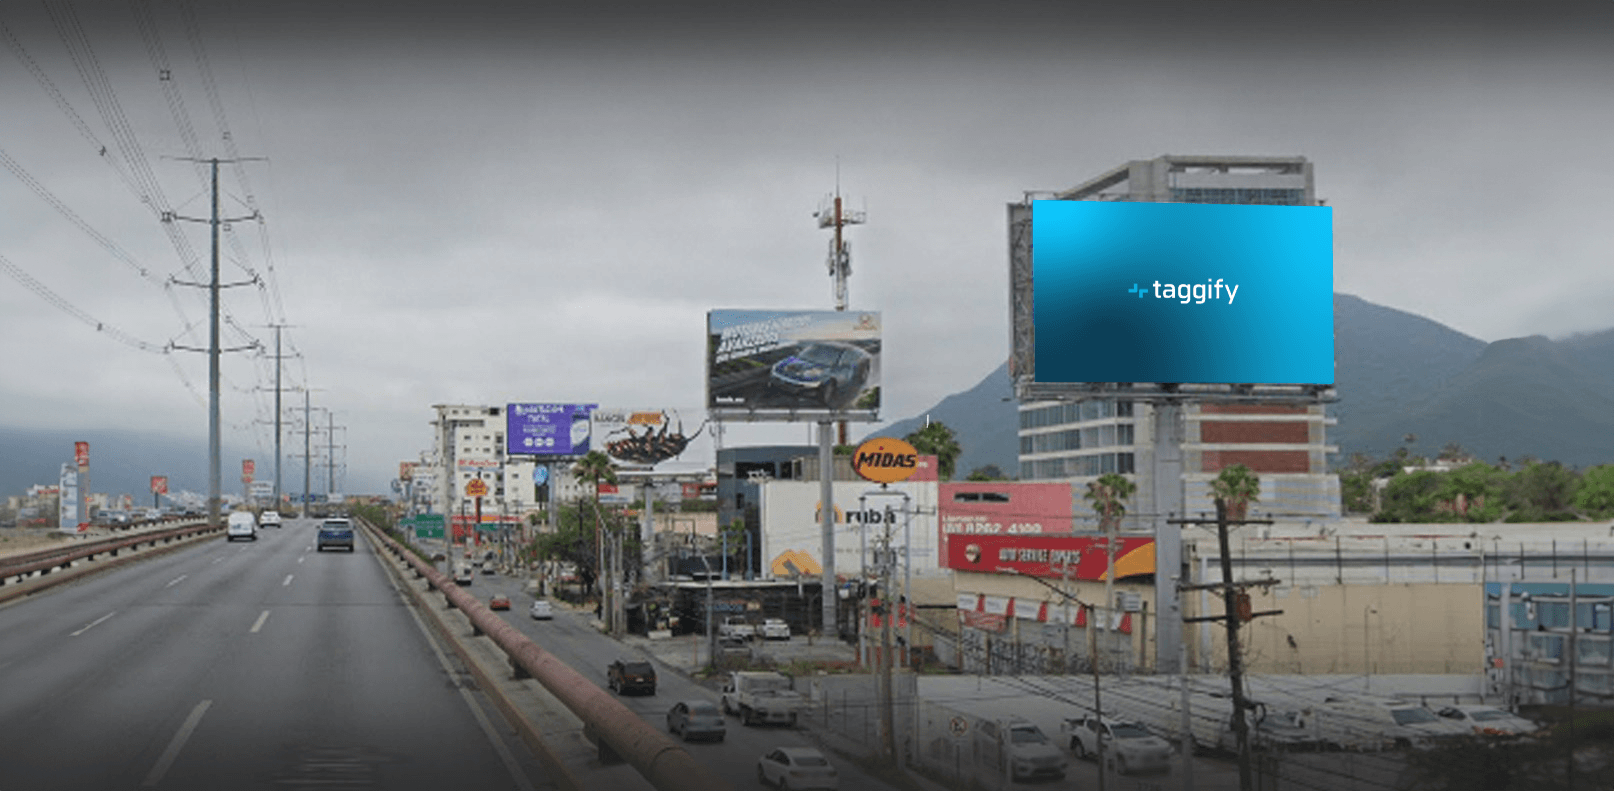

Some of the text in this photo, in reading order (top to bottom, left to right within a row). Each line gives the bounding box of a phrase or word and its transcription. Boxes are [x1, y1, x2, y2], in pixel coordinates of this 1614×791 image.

[1152, 278, 1240, 305] taggify
[858, 447, 917, 469] MIDAS
[846, 508, 896, 524] ruba
